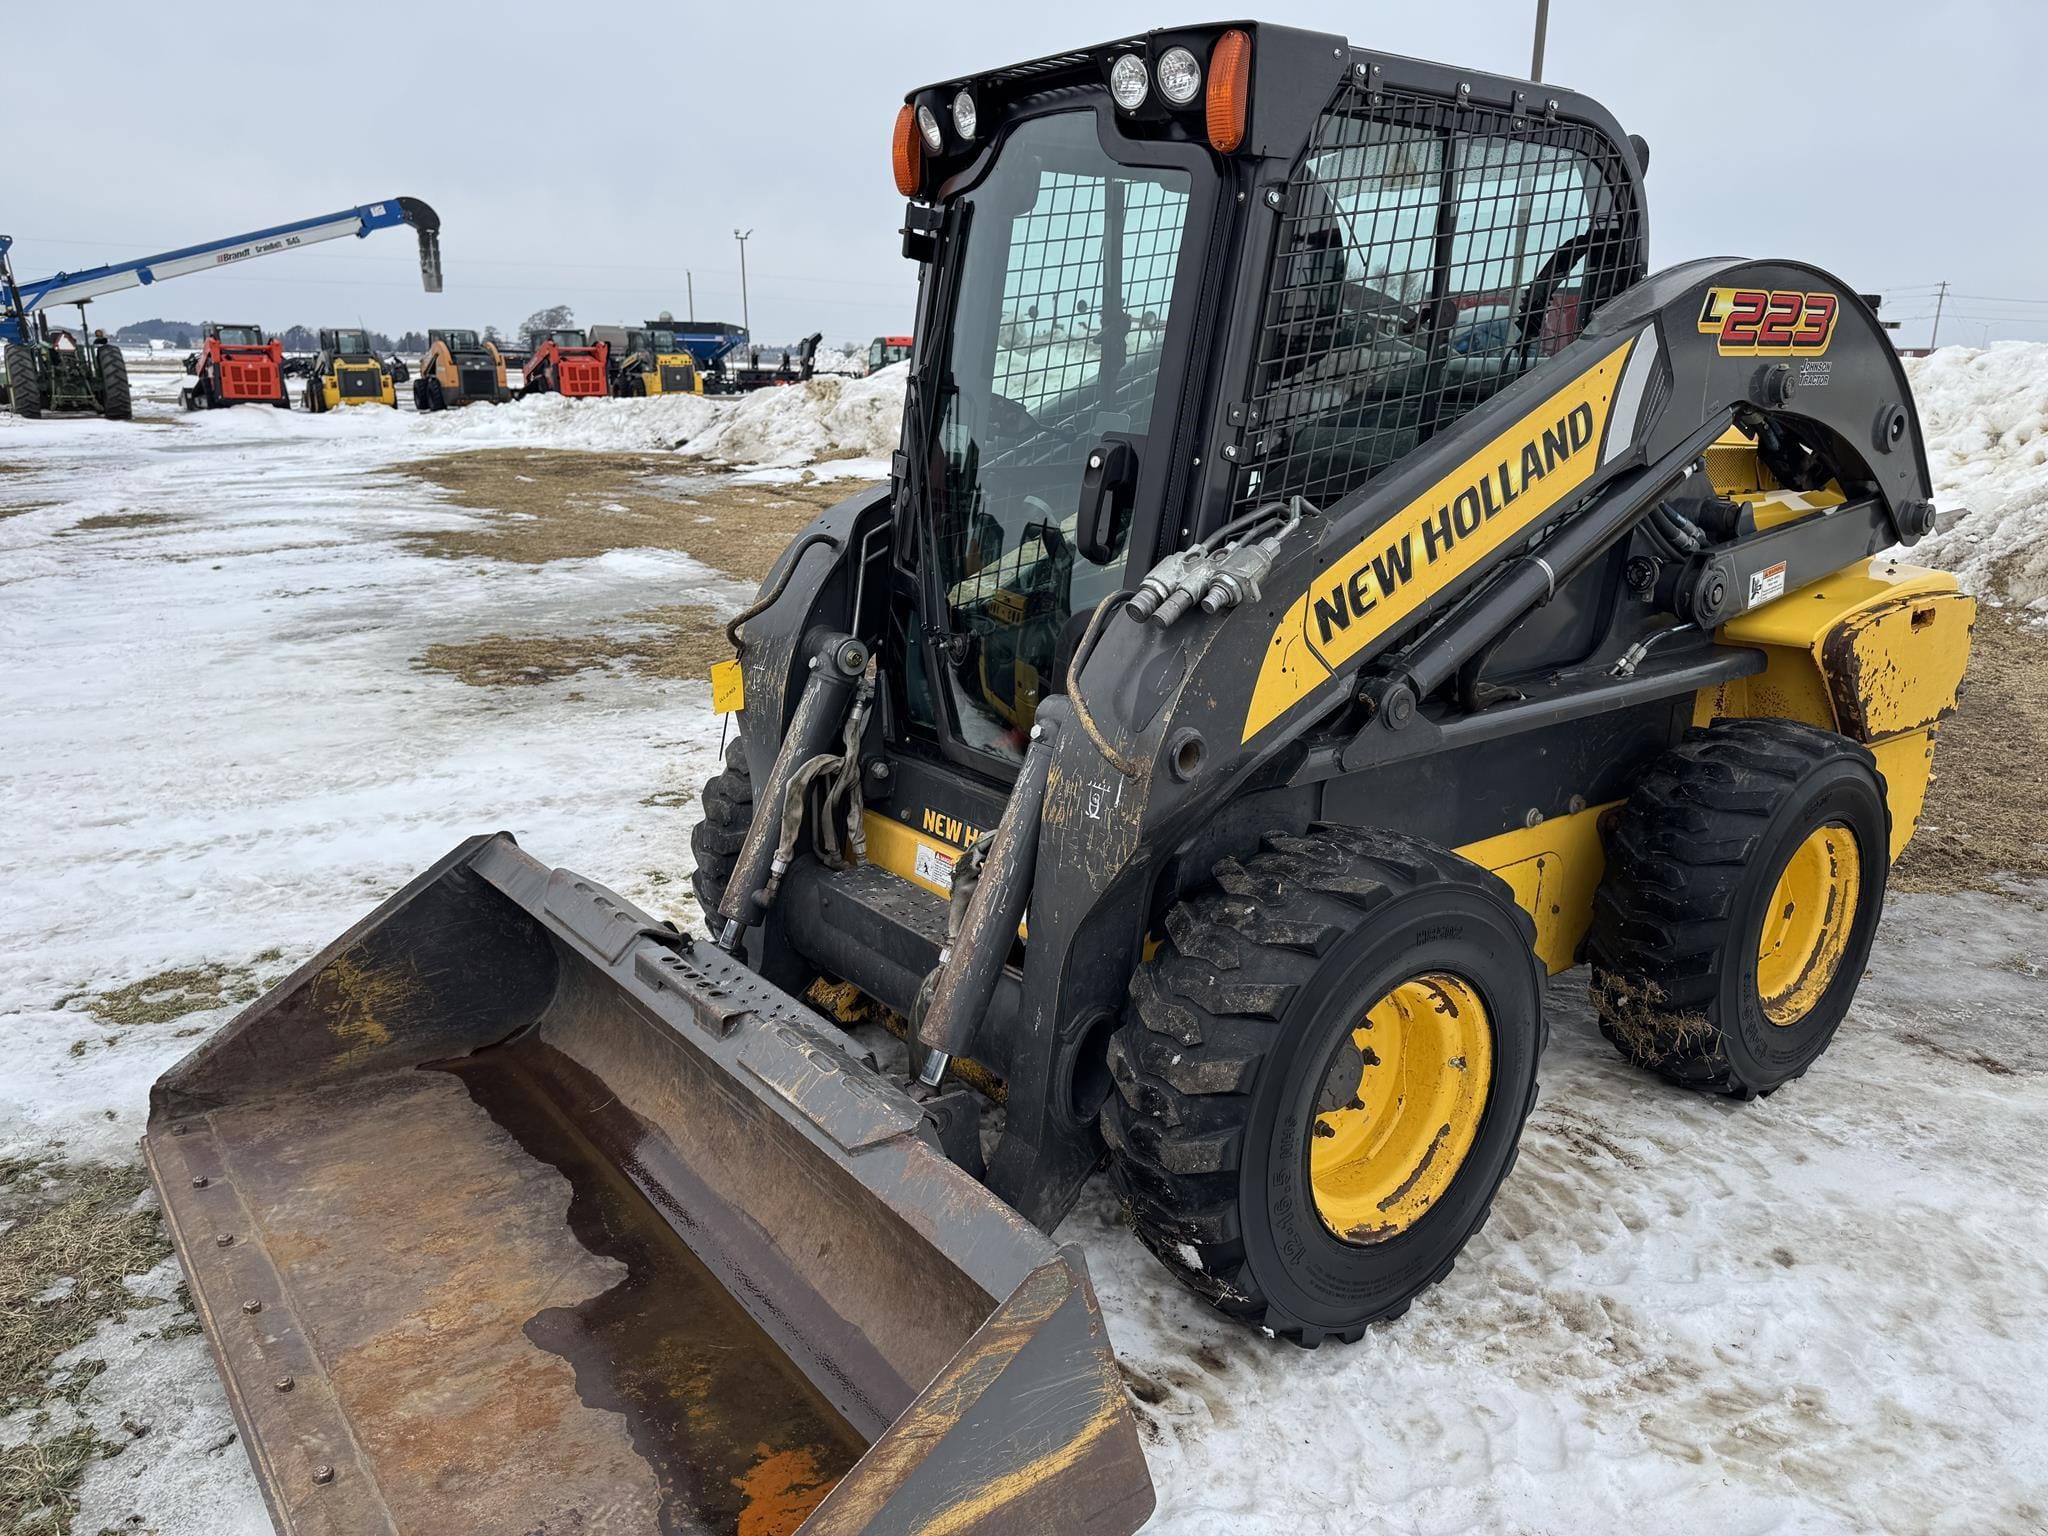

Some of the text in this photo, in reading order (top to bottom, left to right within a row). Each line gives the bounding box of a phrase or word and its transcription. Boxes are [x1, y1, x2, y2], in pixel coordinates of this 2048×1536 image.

[223, 248, 250, 262] Brandt
[1699, 289, 1839, 352] L223
[1800, 358, 1832, 373] JOHNSON
[1798, 372, 1829, 386] TRACTOR
[1312, 400, 1594, 646] NEW HOLLAND
[923, 808, 962, 843] NEW
